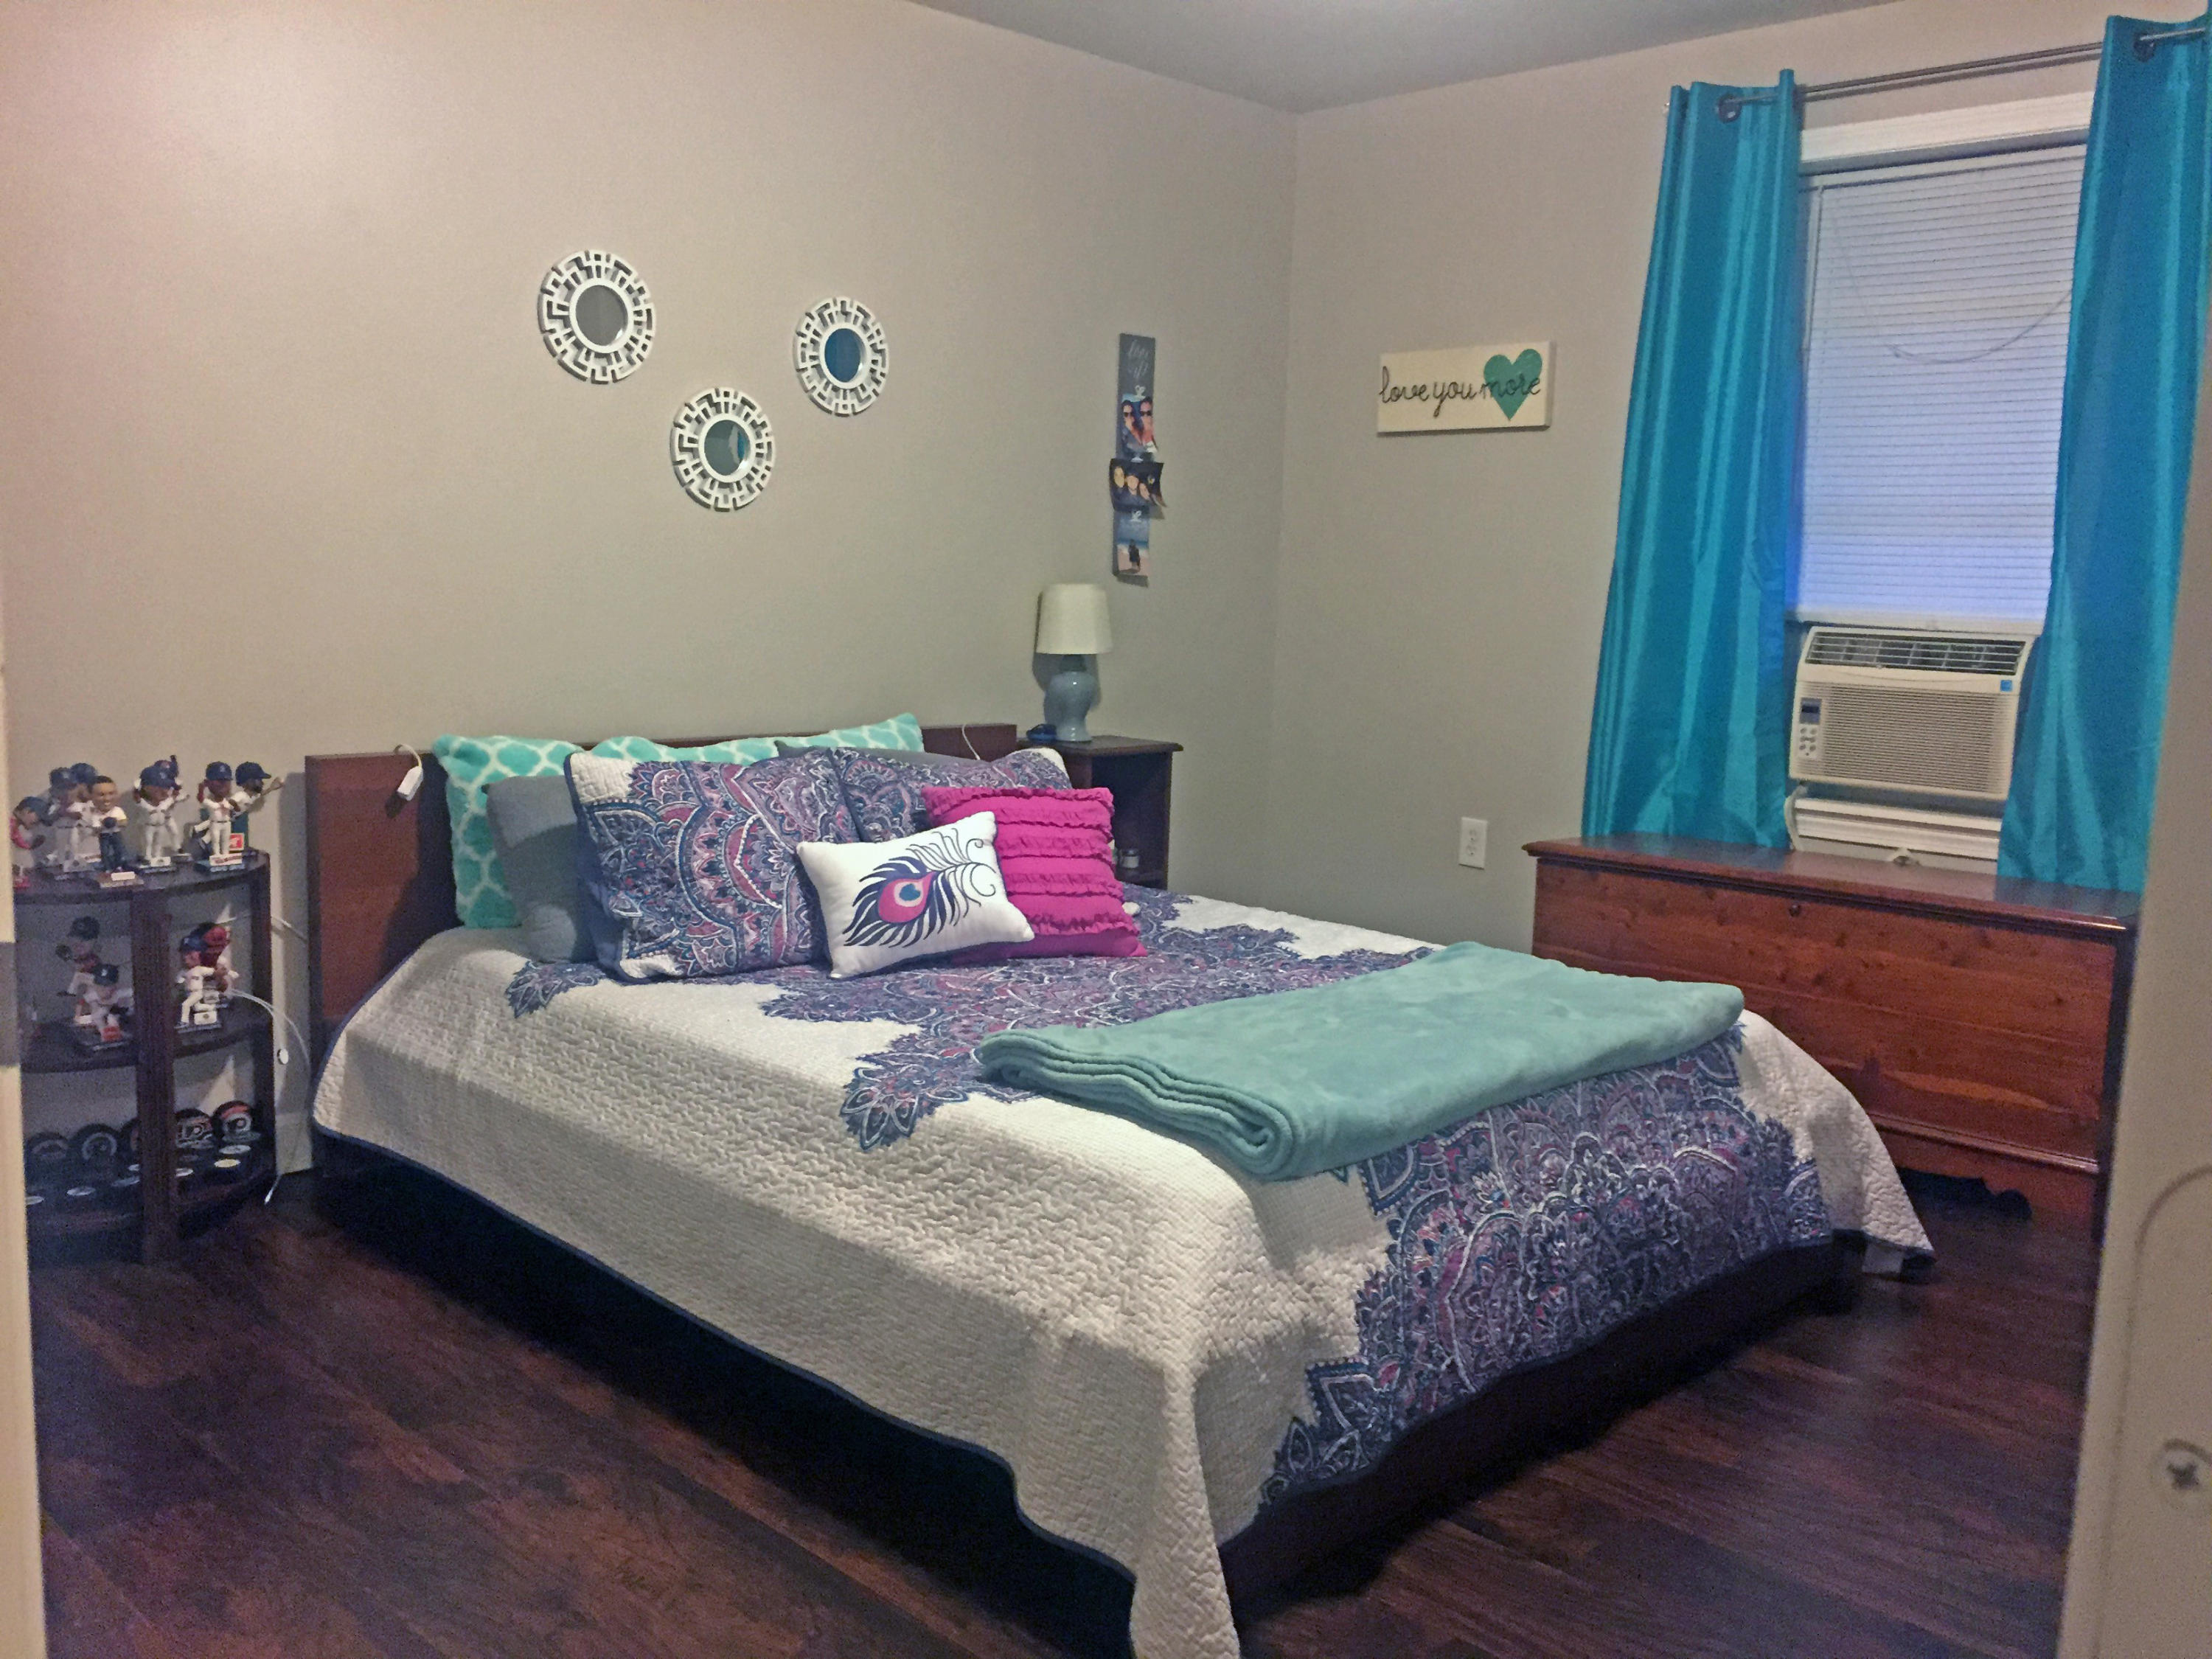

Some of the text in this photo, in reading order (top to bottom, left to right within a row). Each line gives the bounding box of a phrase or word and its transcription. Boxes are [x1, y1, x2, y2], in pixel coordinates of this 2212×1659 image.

[1379, 366, 1541, 417] love you more
